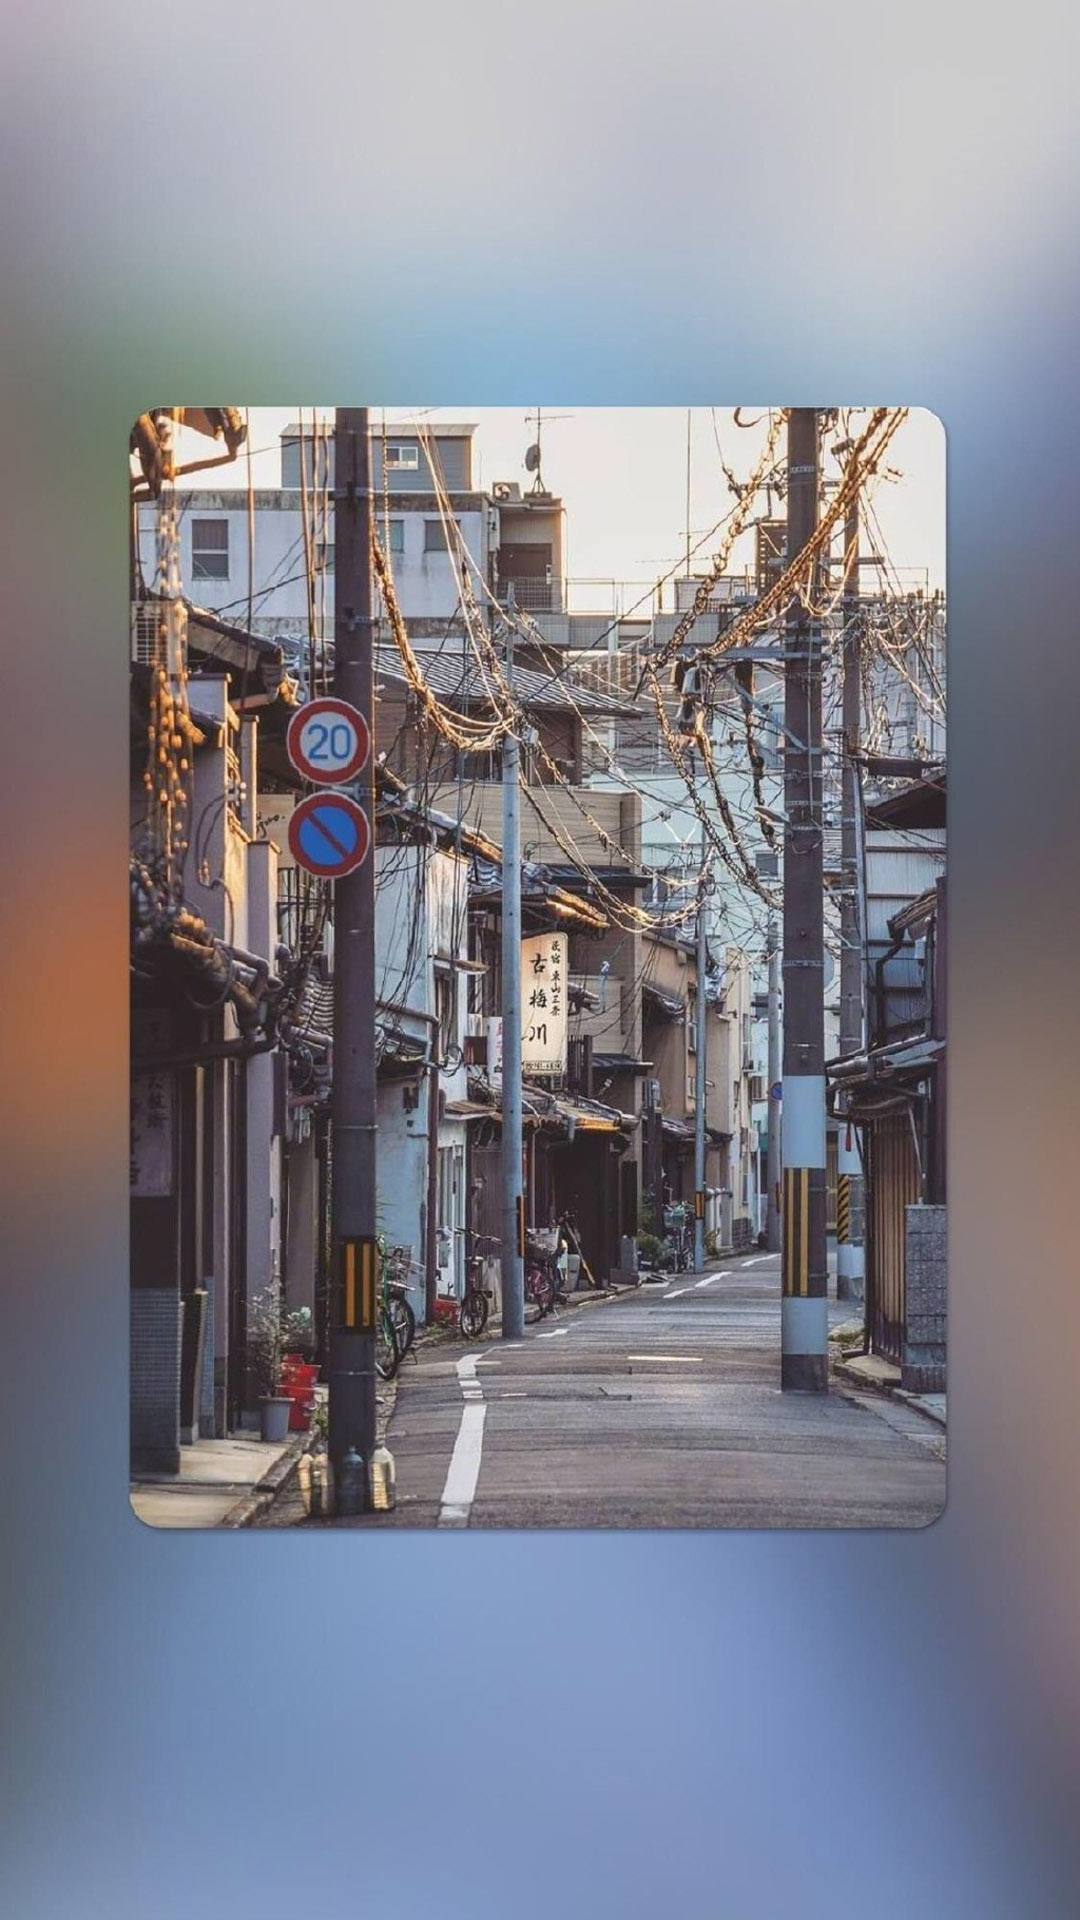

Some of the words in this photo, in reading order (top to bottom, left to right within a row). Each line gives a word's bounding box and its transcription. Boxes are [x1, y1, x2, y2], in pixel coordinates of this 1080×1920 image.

[308, 723, 352, 759] 20
[529, 952, 548, 1046] 古梅川
